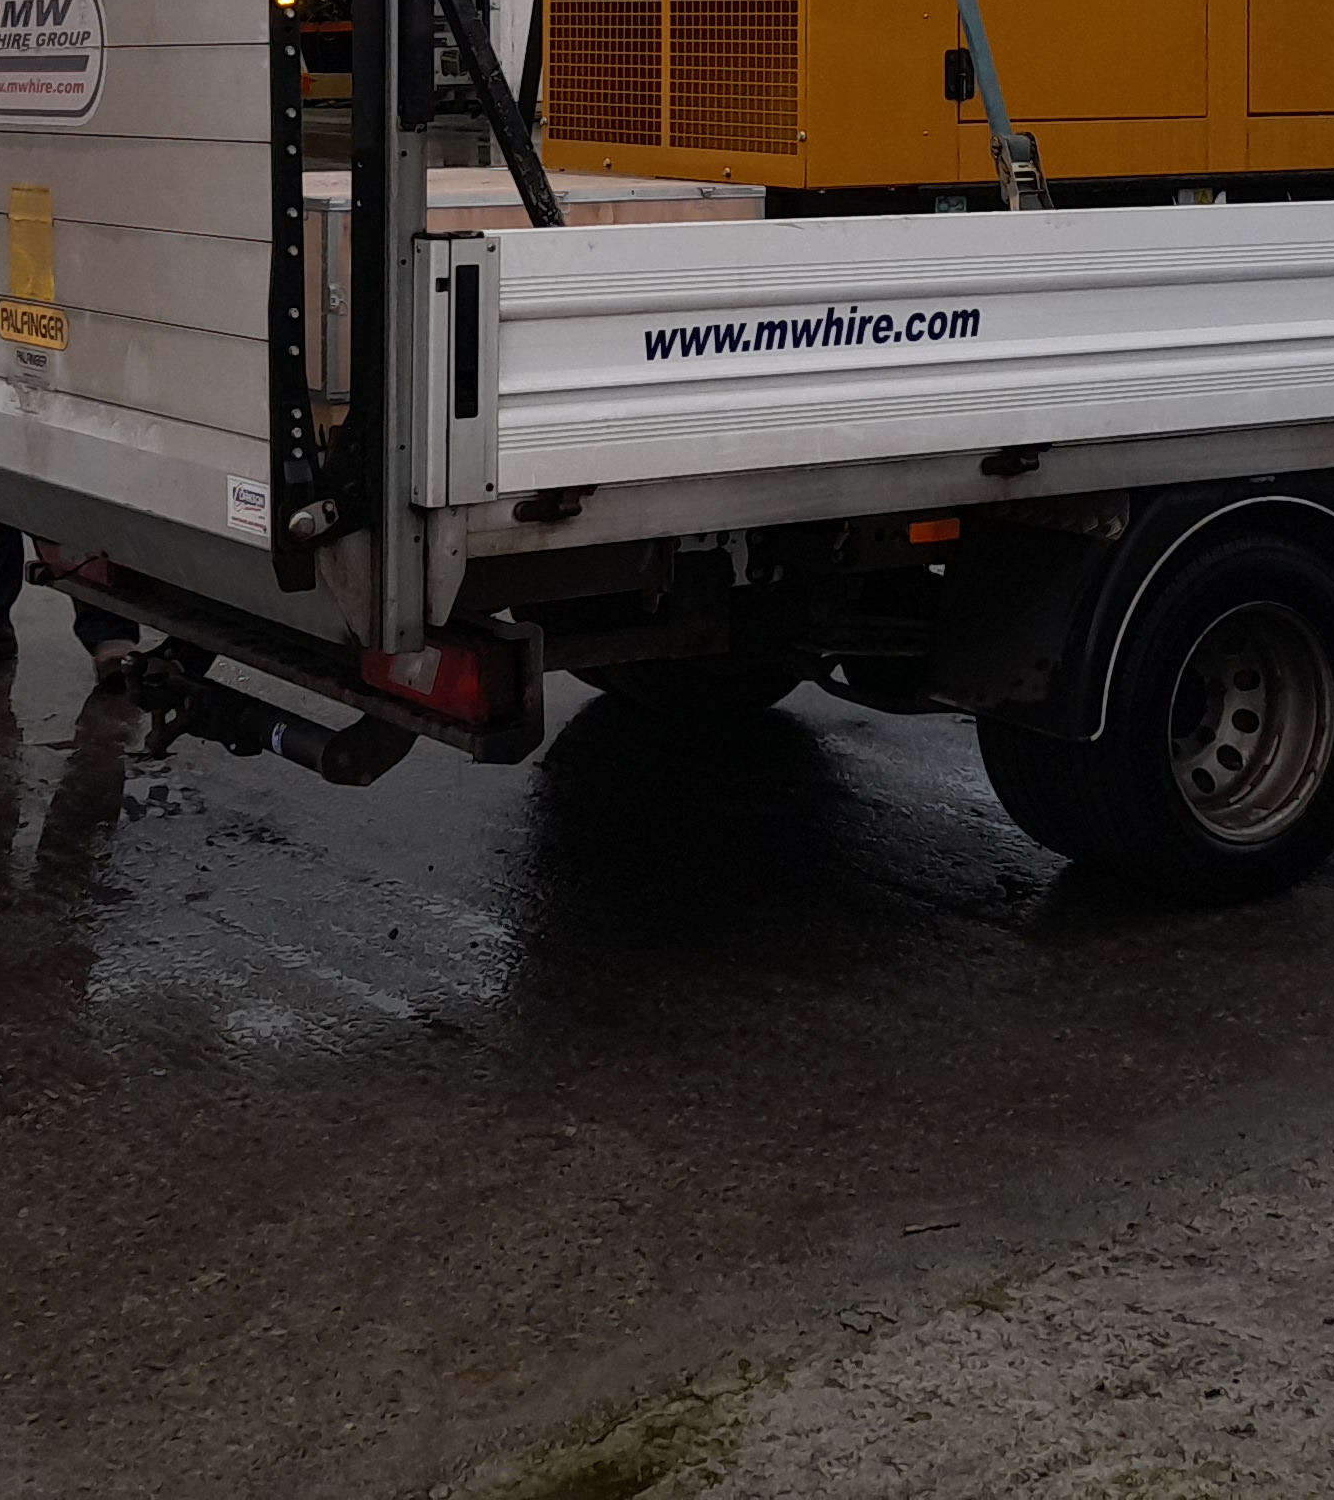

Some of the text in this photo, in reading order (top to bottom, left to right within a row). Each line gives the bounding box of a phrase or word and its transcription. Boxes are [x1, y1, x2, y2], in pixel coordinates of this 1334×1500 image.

[35, 30, 91, 47] GROUP
[0, 307, 65, 343] PALFINGER
[644, 304, 982, 362] www.mwhire.com
